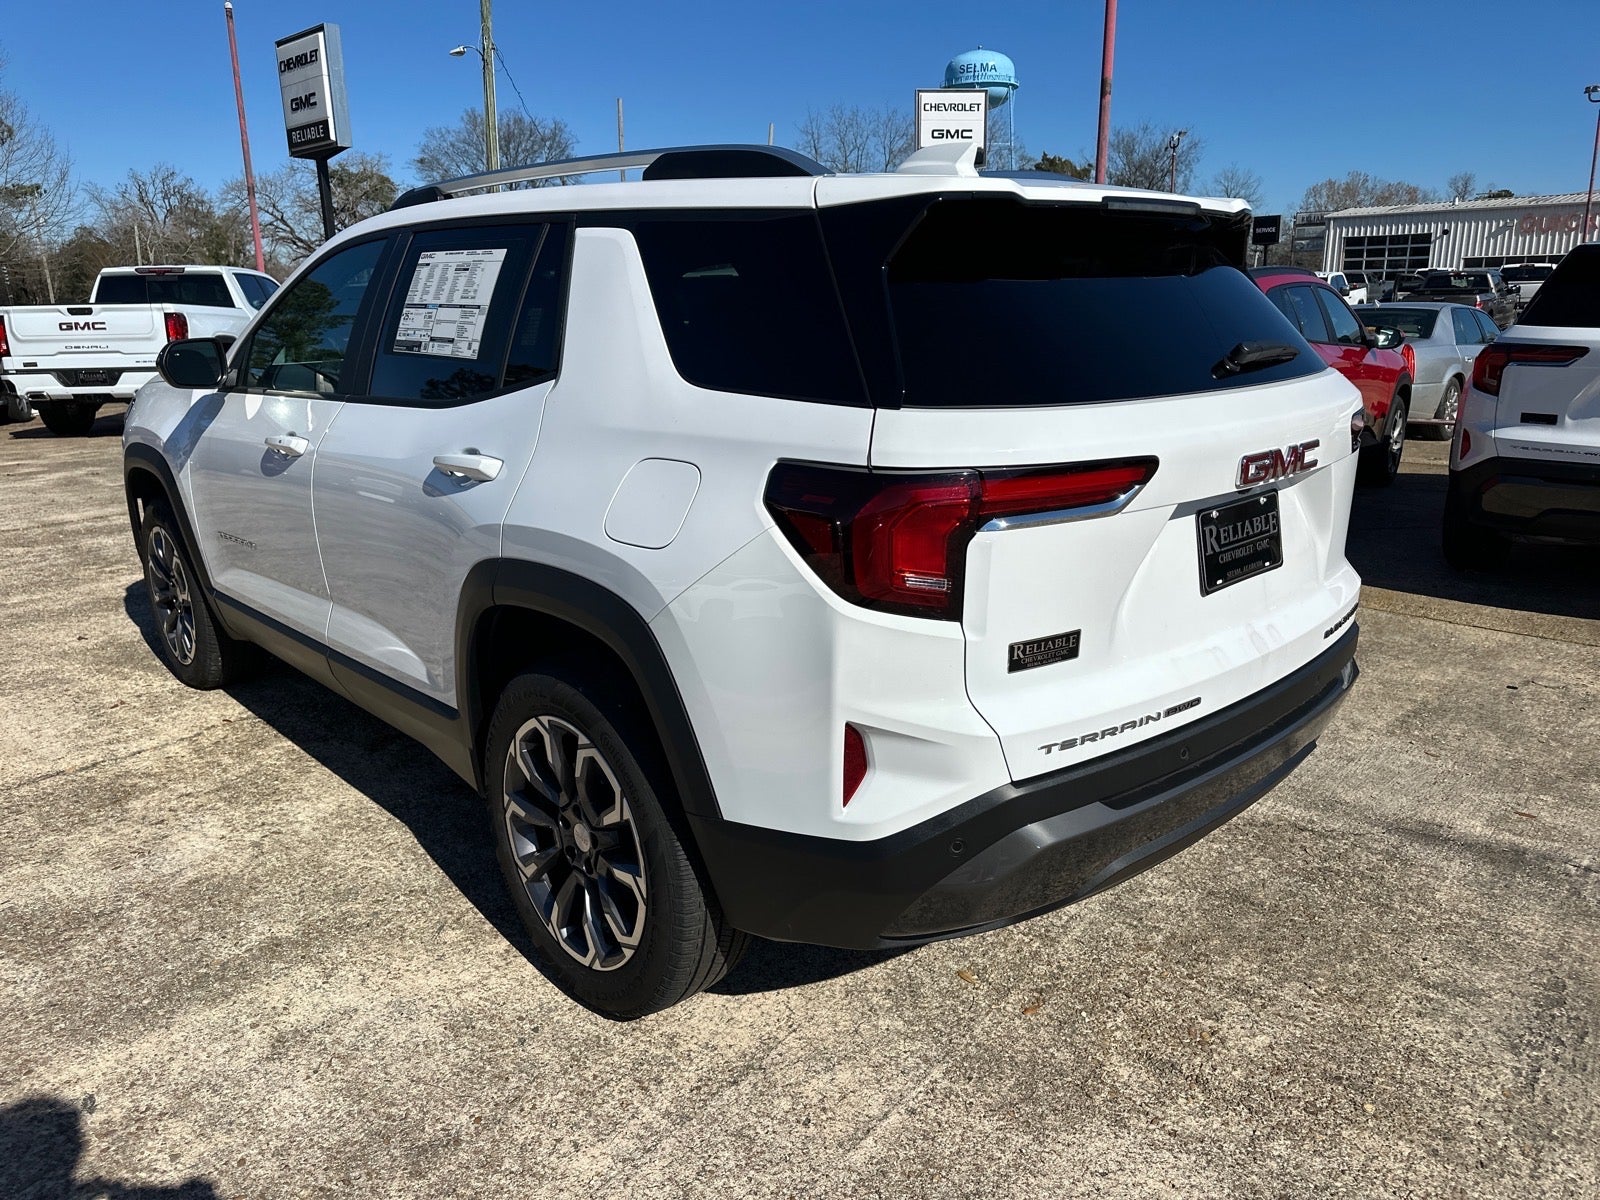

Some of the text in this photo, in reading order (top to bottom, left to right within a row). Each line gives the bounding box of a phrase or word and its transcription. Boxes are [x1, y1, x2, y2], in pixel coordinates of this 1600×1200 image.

[279, 49, 319, 73] CHEVROLET
[959, 62, 997, 74] SELMA
[290, 92, 317, 112] GMC
[923, 103, 982, 112] CHEVROLET
[291, 125, 324, 143] RELIABLE
[931, 129, 973, 139] GMC
[58, 321, 107, 331] GMC
[1235, 438, 1320, 489] GMC
[1203, 511, 1279, 556] RELIABLE
[1218, 538, 1270, 564] CHEVROLET GMC
[1012, 634, 1078, 661] RELIABLE
[1020, 648, 1070, 665] CHEVROLET GMC
[1038, 711, 1162, 755] TERRAIN
